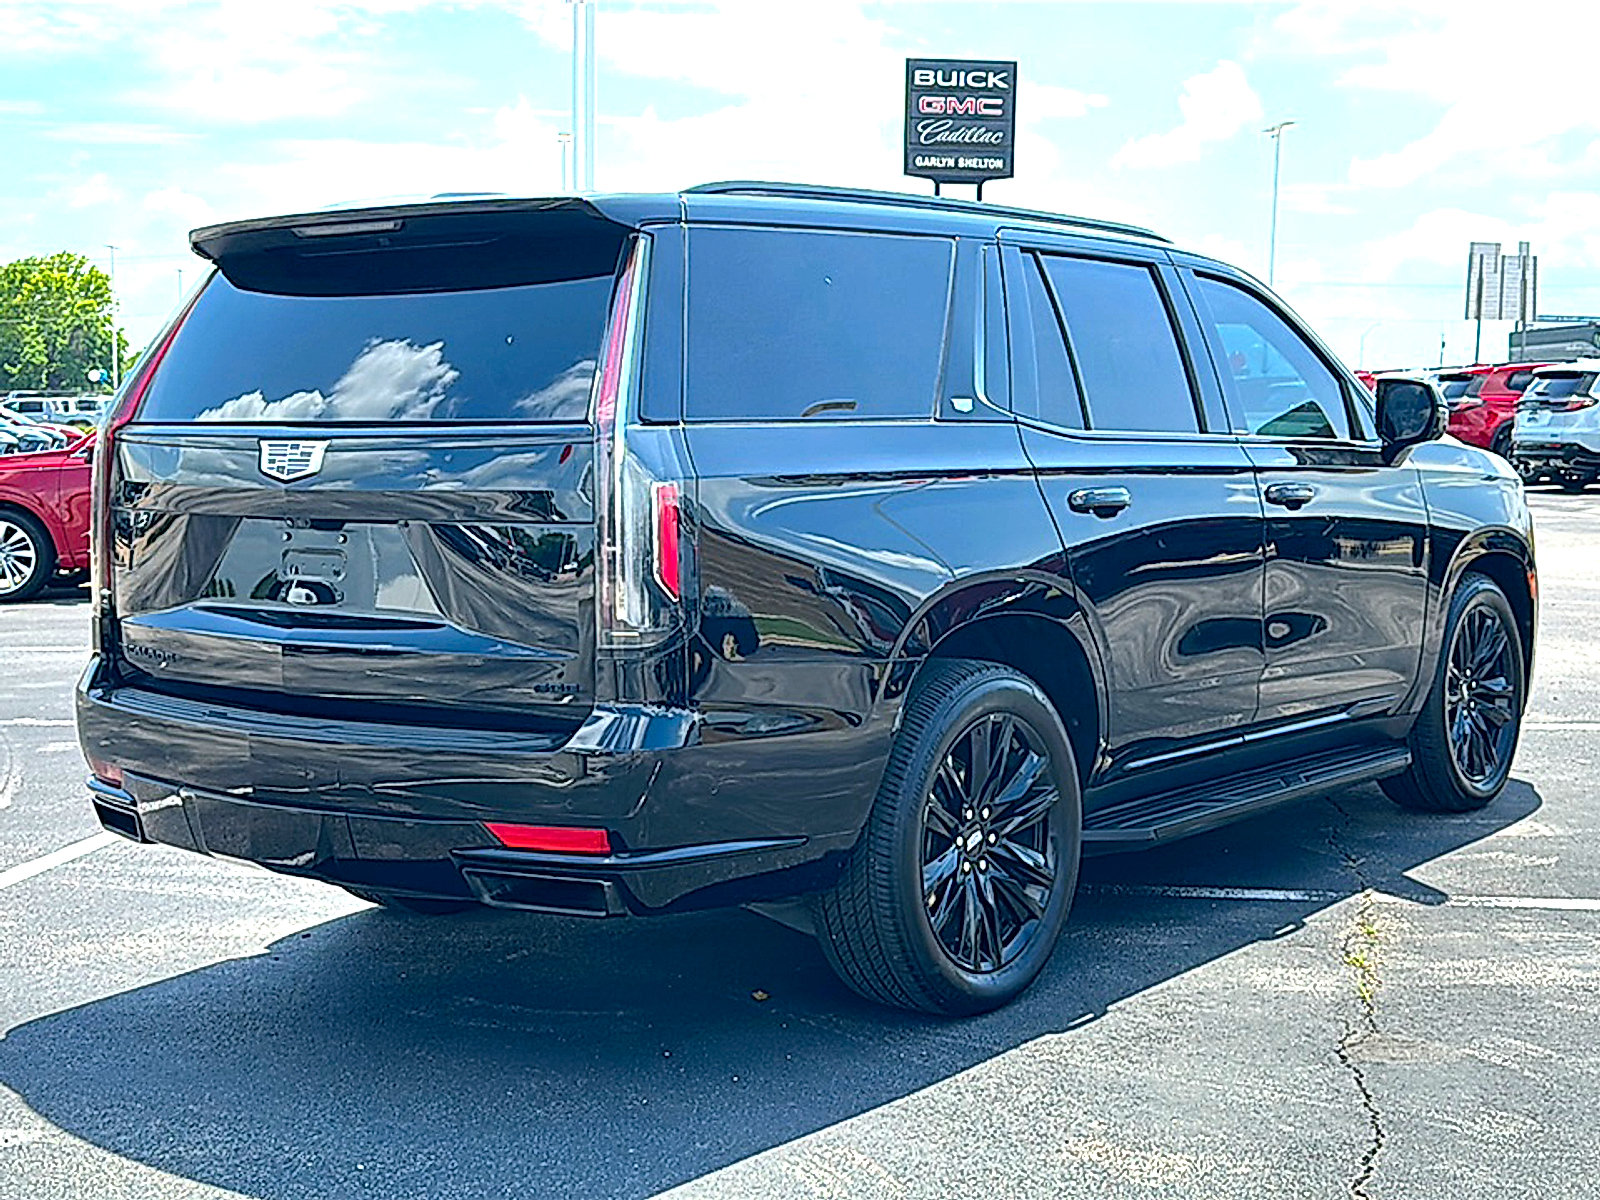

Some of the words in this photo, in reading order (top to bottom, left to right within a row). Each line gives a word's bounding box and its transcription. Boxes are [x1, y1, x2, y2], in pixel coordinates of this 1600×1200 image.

[913, 69, 1009, 89] BUICK
[918, 95, 1004, 116] GMC
[916, 119, 1004, 145] Cadillac
[914, 155, 955, 168] GARLYN
[957, 156, 1004, 169] SHELTON
